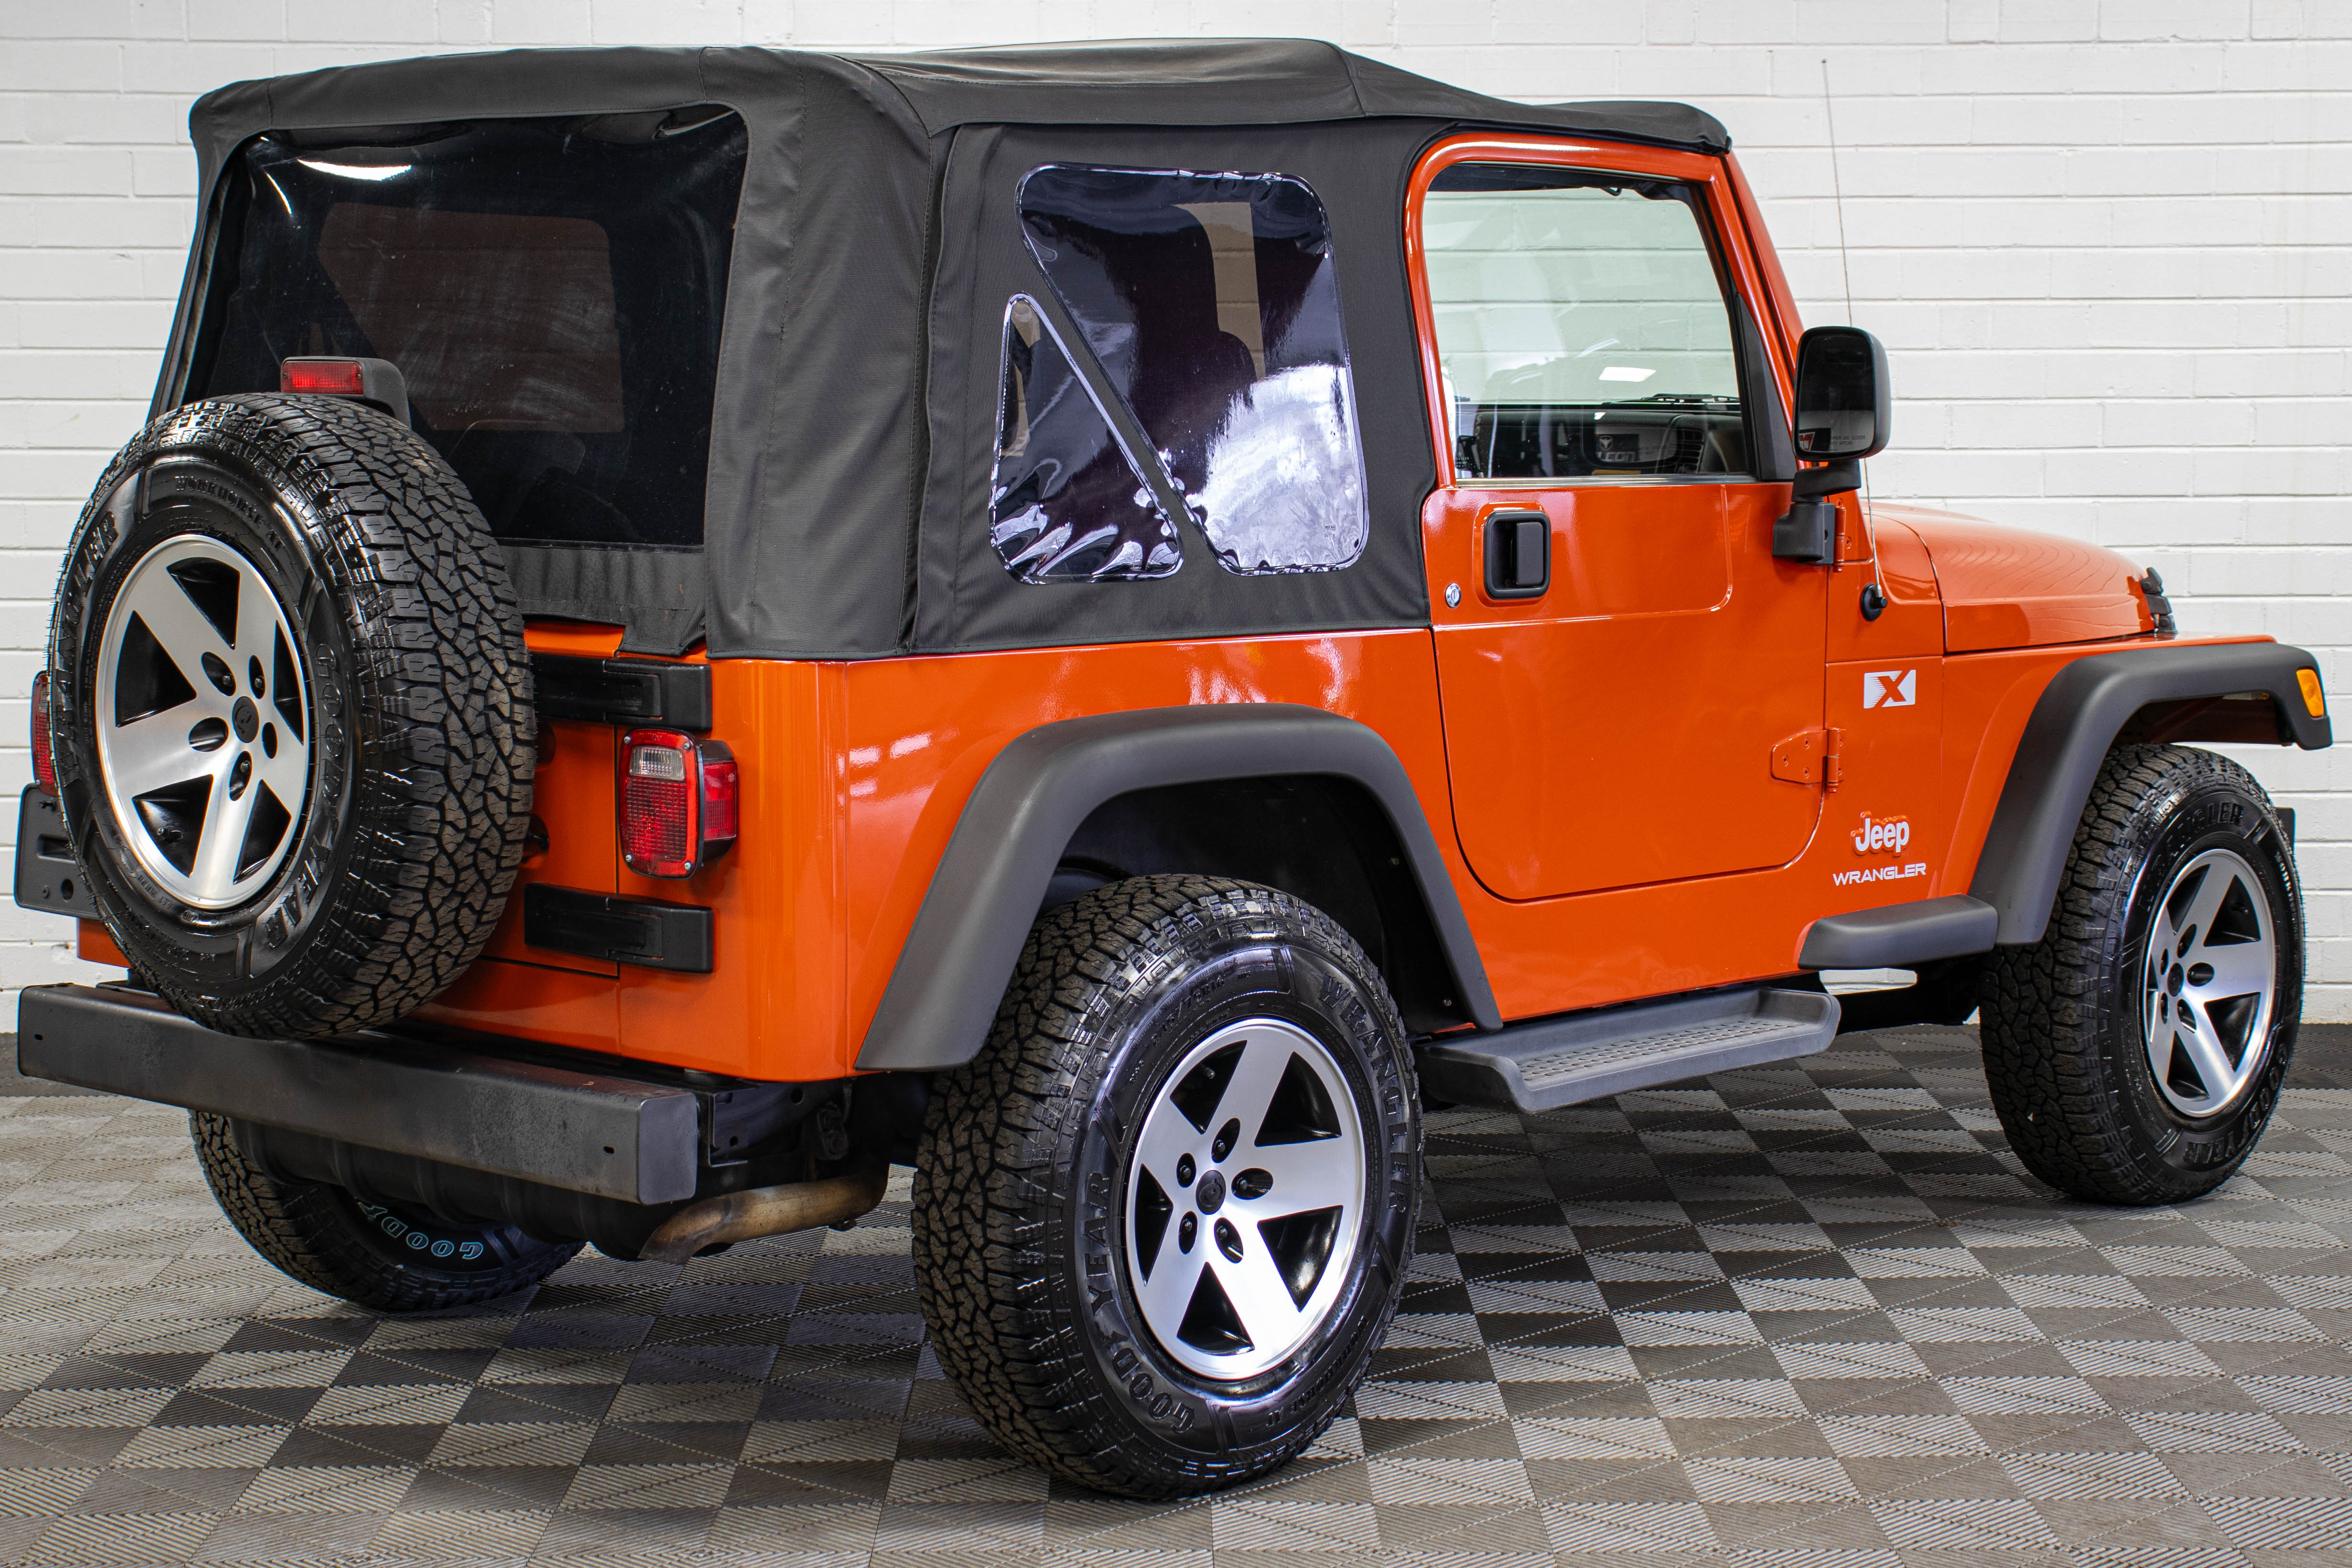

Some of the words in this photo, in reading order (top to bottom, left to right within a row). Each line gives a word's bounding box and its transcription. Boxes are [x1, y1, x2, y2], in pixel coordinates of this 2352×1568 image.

[174, 476, 263, 524] WORKHORSE
[266, 529, 285, 550] AT
[56, 511, 118, 787] WRANGLER
[1872, 669, 1913, 708] X
[1855, 817, 1910, 853] Jeep
[1832, 863, 1927, 886] WRANGLER
[1318, 971, 1410, 1213] WRANGLER
[1291, 1315, 1369, 1414] WORKHORSE
